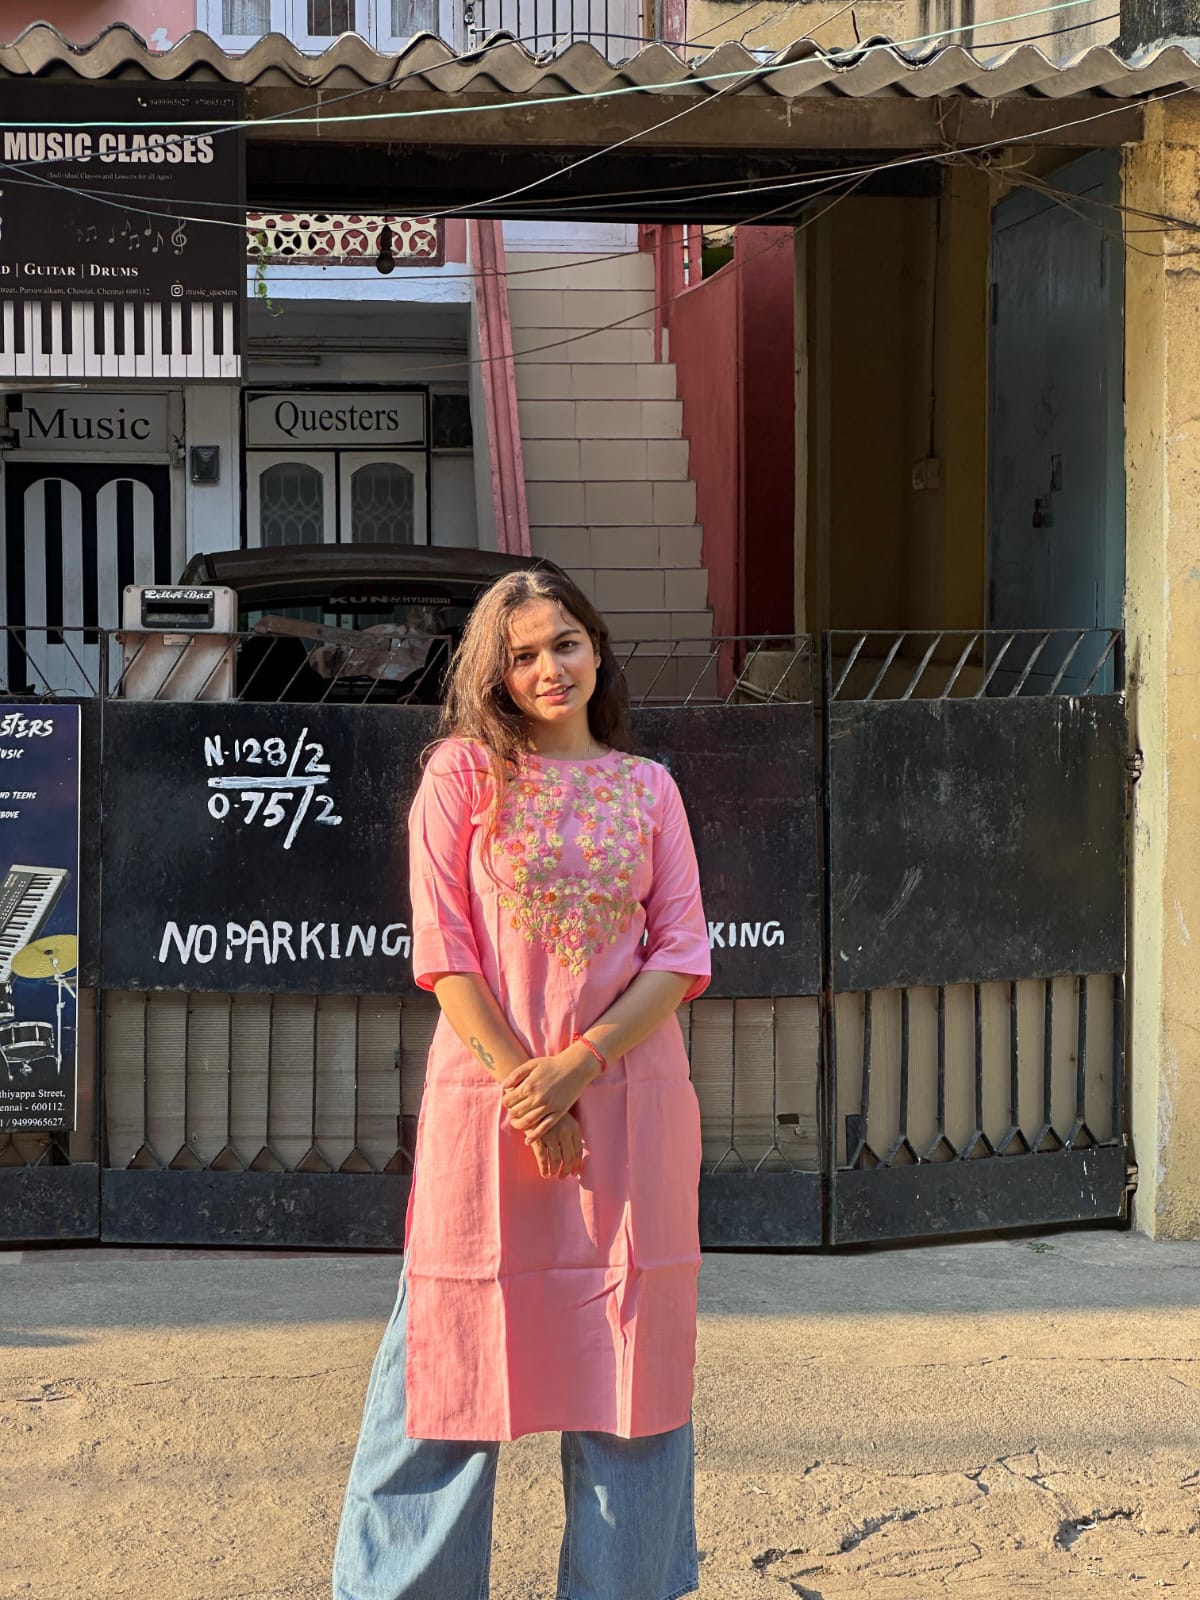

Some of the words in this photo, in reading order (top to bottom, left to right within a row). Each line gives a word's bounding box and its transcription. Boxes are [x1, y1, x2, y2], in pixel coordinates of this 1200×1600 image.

[4, 132, 92, 162] MUSIC
[99, 133, 214, 164] CLASSES
[0, 265, 10, 275] D
[24, 407, 151, 441] Music
[275, 400, 400, 438] Questers
[329, 595, 388, 604] KUN
[0, 712, 54, 738] STERS
[0, 747, 24, 760] USIC
[0, 791, 10, 800] ND
[12, 791, 37, 800] TEENS
[0, 810, 21, 819] BOVE
[707, 920, 785, 949] KING
[0, 1089, 36, 1100] thiyappa
[38, 1088, 66, 1099] Street,
[0, 1102, 23, 1111] ennai
[31, 1102, 65, 1111] 600112.
[11, 1117, 65, 1127] 9499965627.
